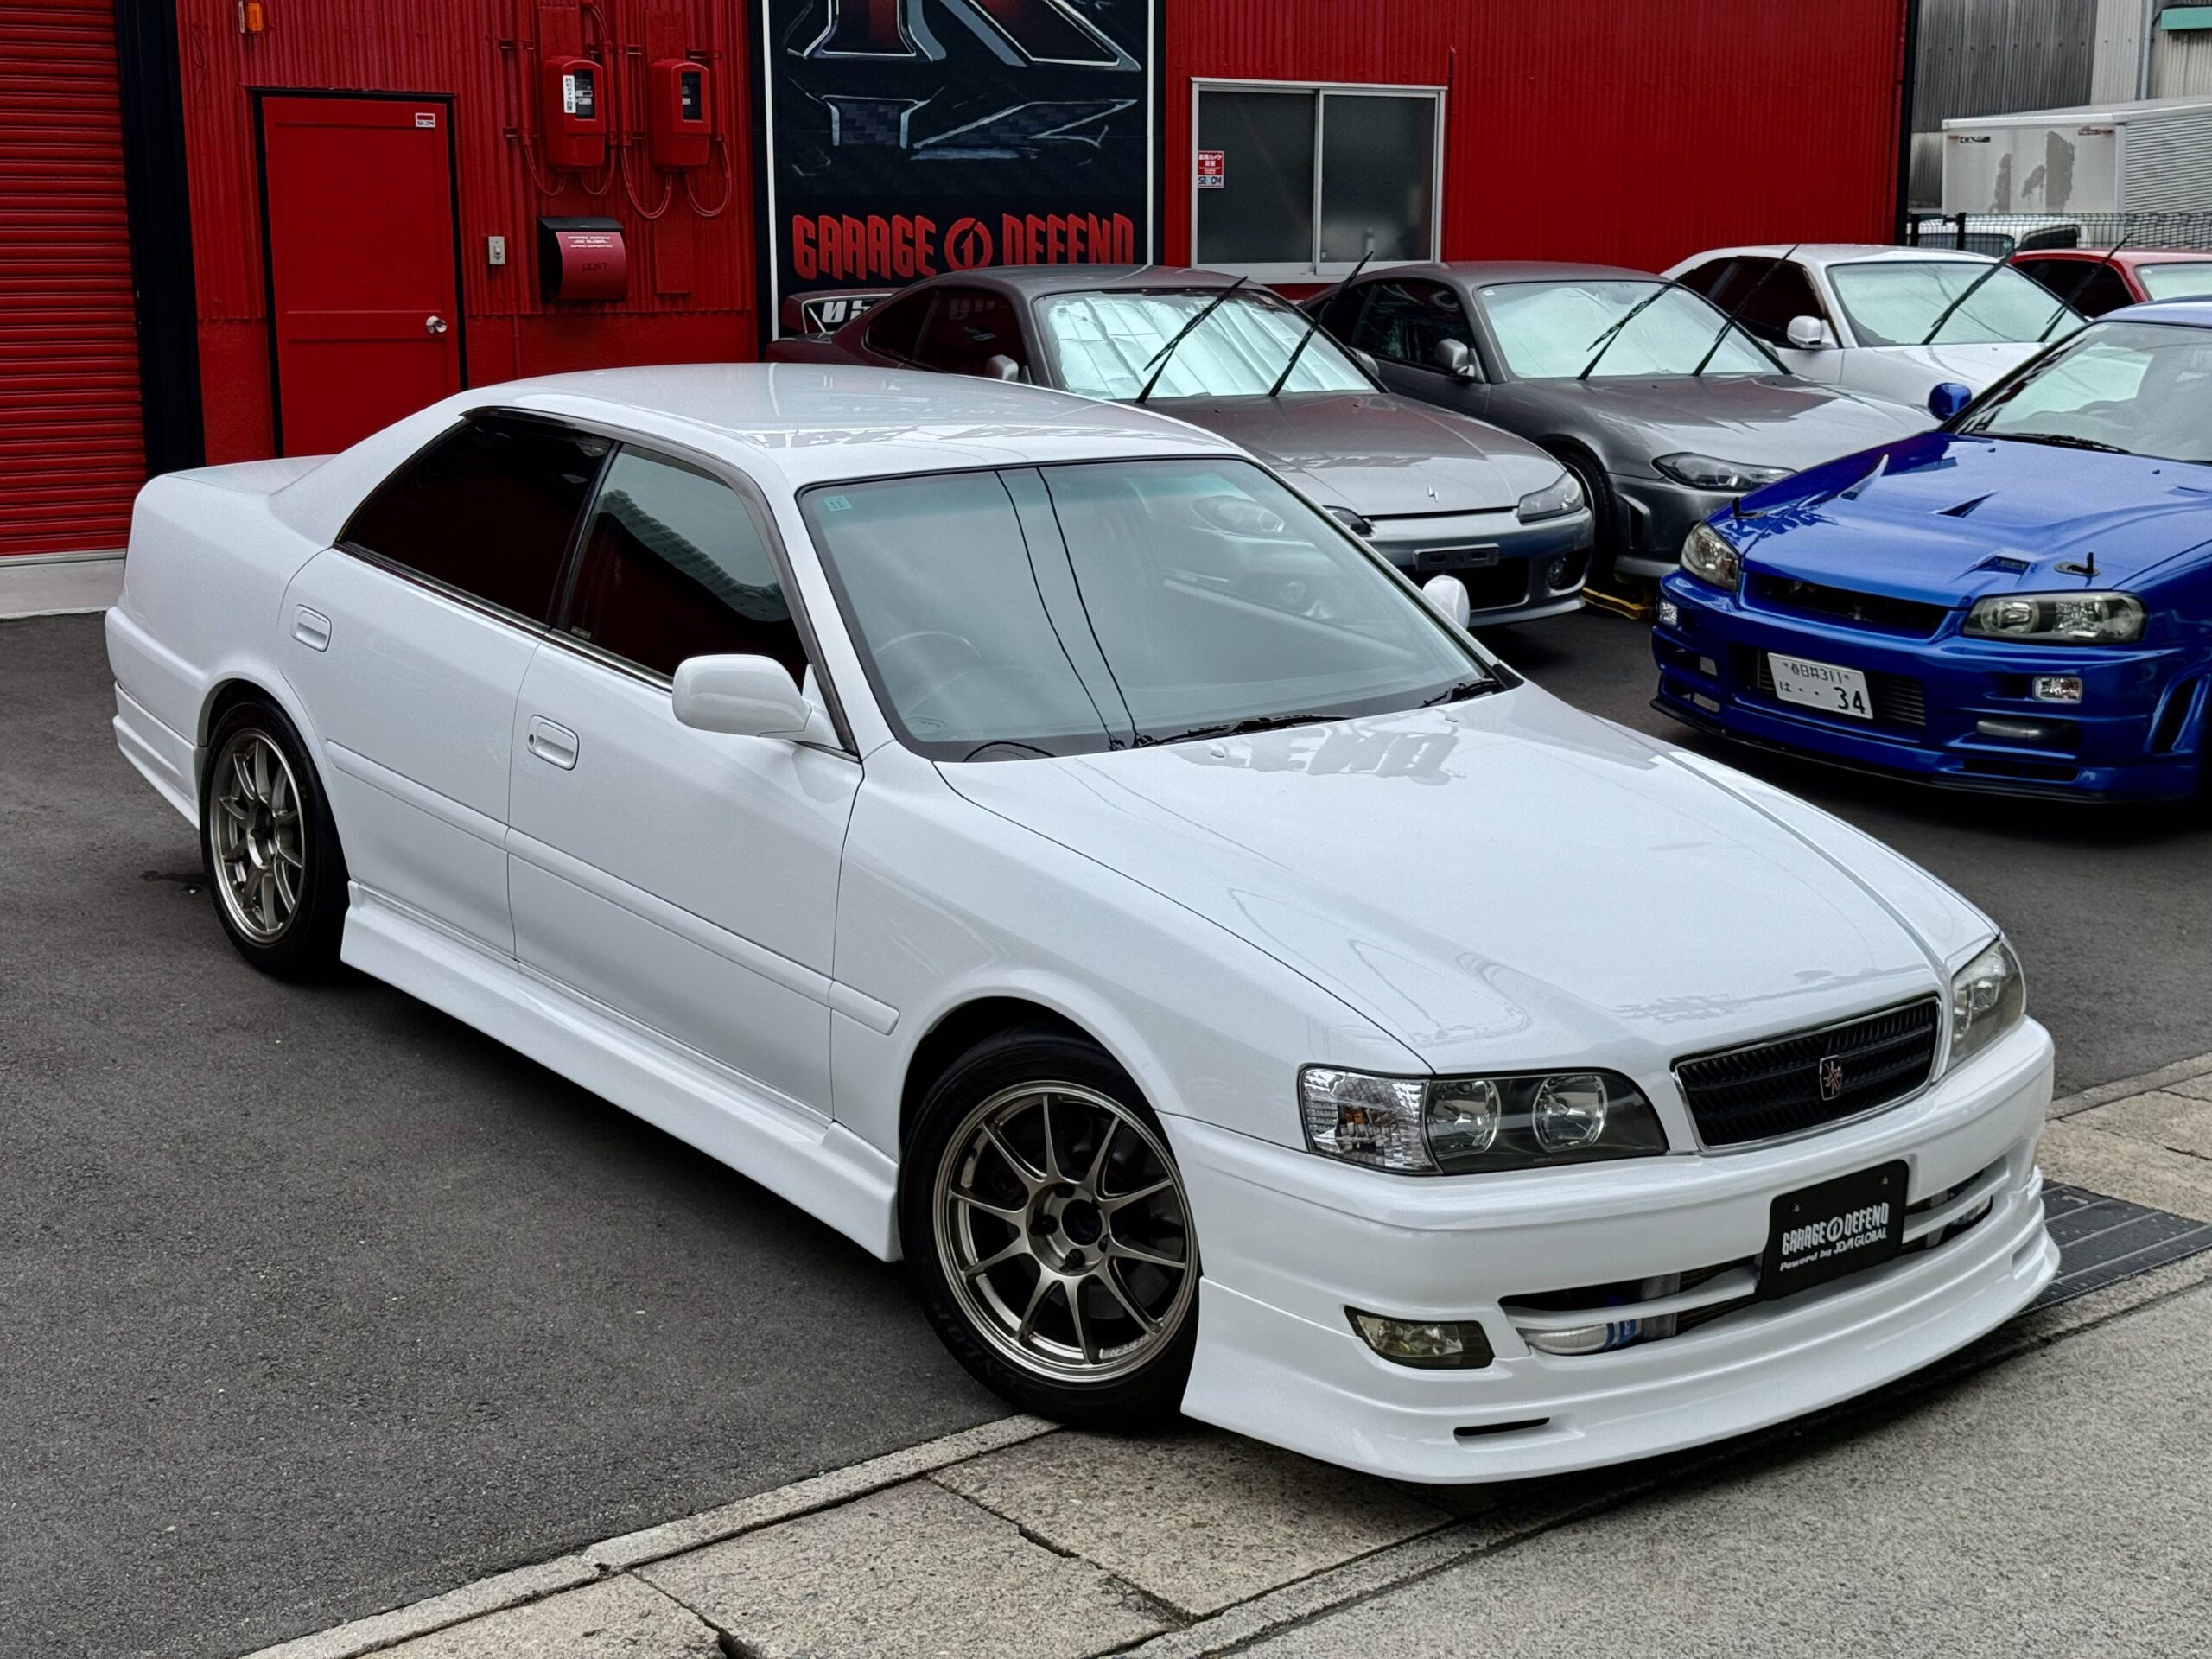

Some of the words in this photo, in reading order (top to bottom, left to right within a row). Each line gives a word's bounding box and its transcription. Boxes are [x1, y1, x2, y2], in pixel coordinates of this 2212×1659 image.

[1198, 176, 1222, 185] SEOM
[792, 214, 937, 281] GARAGE
[1002, 213, 1135, 267] DEFEND
[1782, 1221, 1827, 1256] GARAGE
[1844, 1202, 1890, 1236] DEFEND
